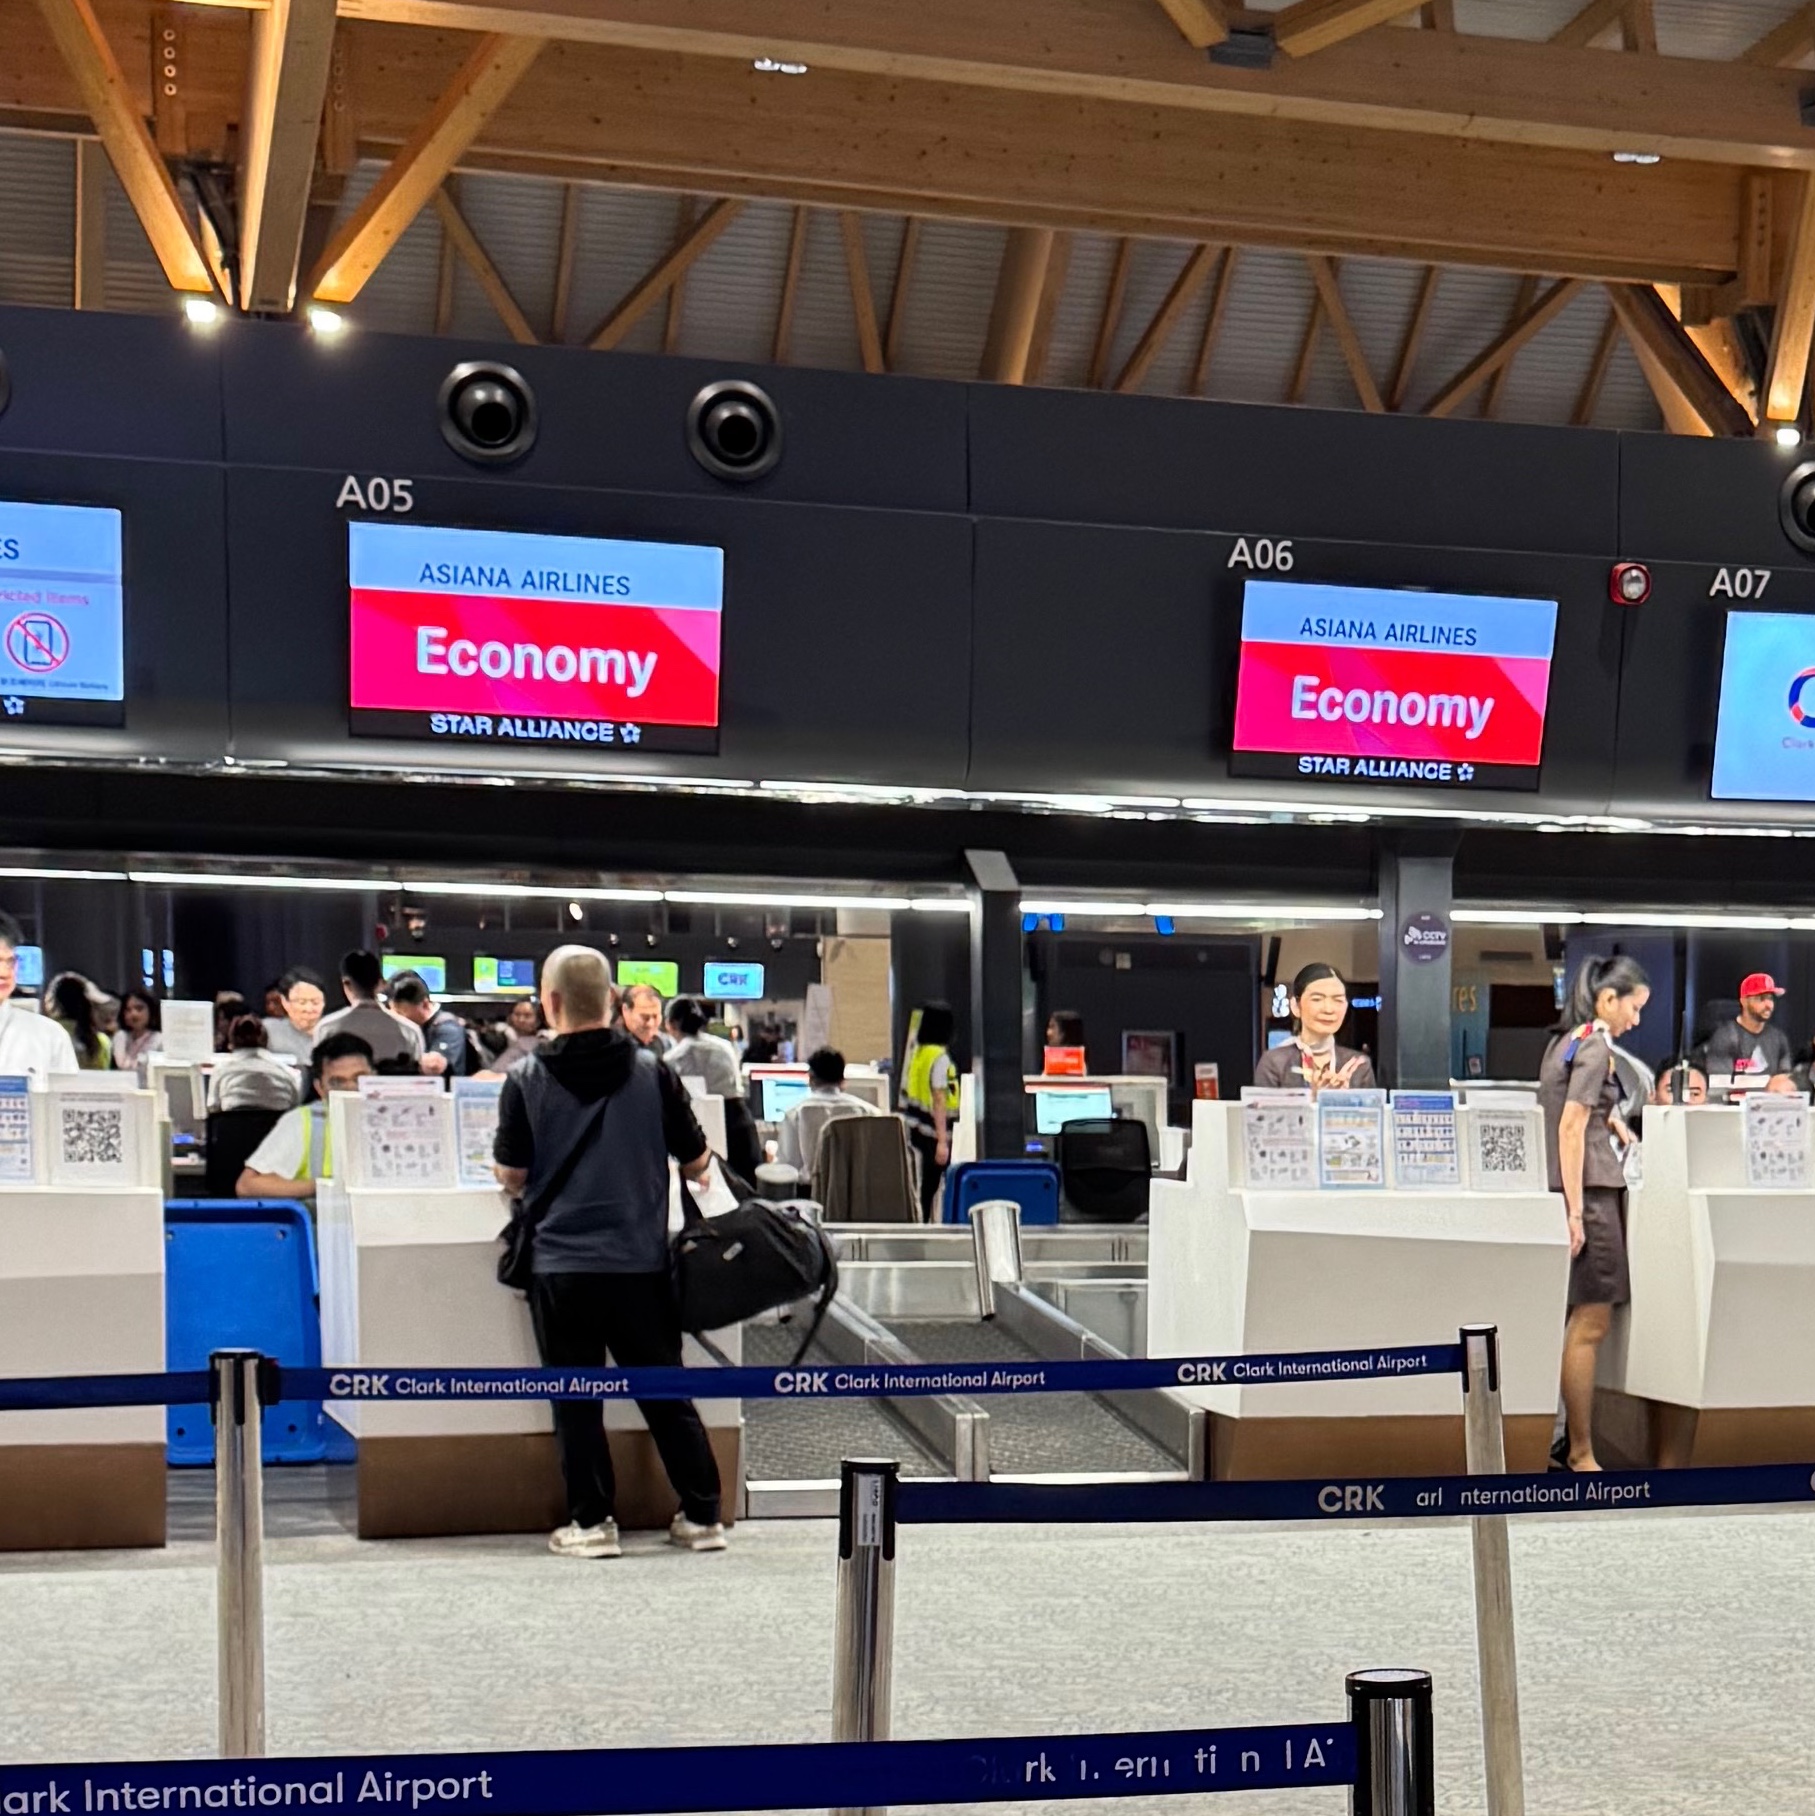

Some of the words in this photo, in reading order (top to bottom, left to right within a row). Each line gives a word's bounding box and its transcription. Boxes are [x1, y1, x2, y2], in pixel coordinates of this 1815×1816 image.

[336, 475, 414, 513] A05
[1227, 537, 1295, 572] A06
[419, 562, 512, 589] ASIANA
[520, 569, 631, 597] AIRLINES
[1708, 567, 1772, 600] A07
[1299, 616, 1378, 641] ASIANA
[1383, 622, 1478, 647] AIRLINES
[415, 625, 658, 698] Economy
[1291, 674, 1496, 740] Economy
[430, 712, 492, 737] STAR
[497, 716, 614, 743] ALLIANCE
[1298, 755, 1350, 775] STAR
[1354, 758, 1452, 781] ALLIANCE
[329, 1373, 389, 1396] CRK
[395, 1376, 446, 1395] Clark
[450, 1375, 564, 1395] International
[568, 1375, 630, 1398] Airport
[773, 1371, 829, 1394] CRK
[834, 1372, 881, 1390] Clark
[884, 1370, 987, 1389] International
[991, 1371, 1046, 1390] Airport
[1176, 1362, 1227, 1384] CRK
[1233, 1361, 1275, 1378] Clark
[1278, 1355, 1374, 1377] International
[1377, 1354, 1428, 1372] Airport
[1317, 1484, 1385, 1514] CRK
[1460, 1482, 1579, 1506] nternational
[1585, 1481, 1651, 1505] Airport
[84, 1771, 344, 1812] International
[357, 1769, 494, 1810] Airport
